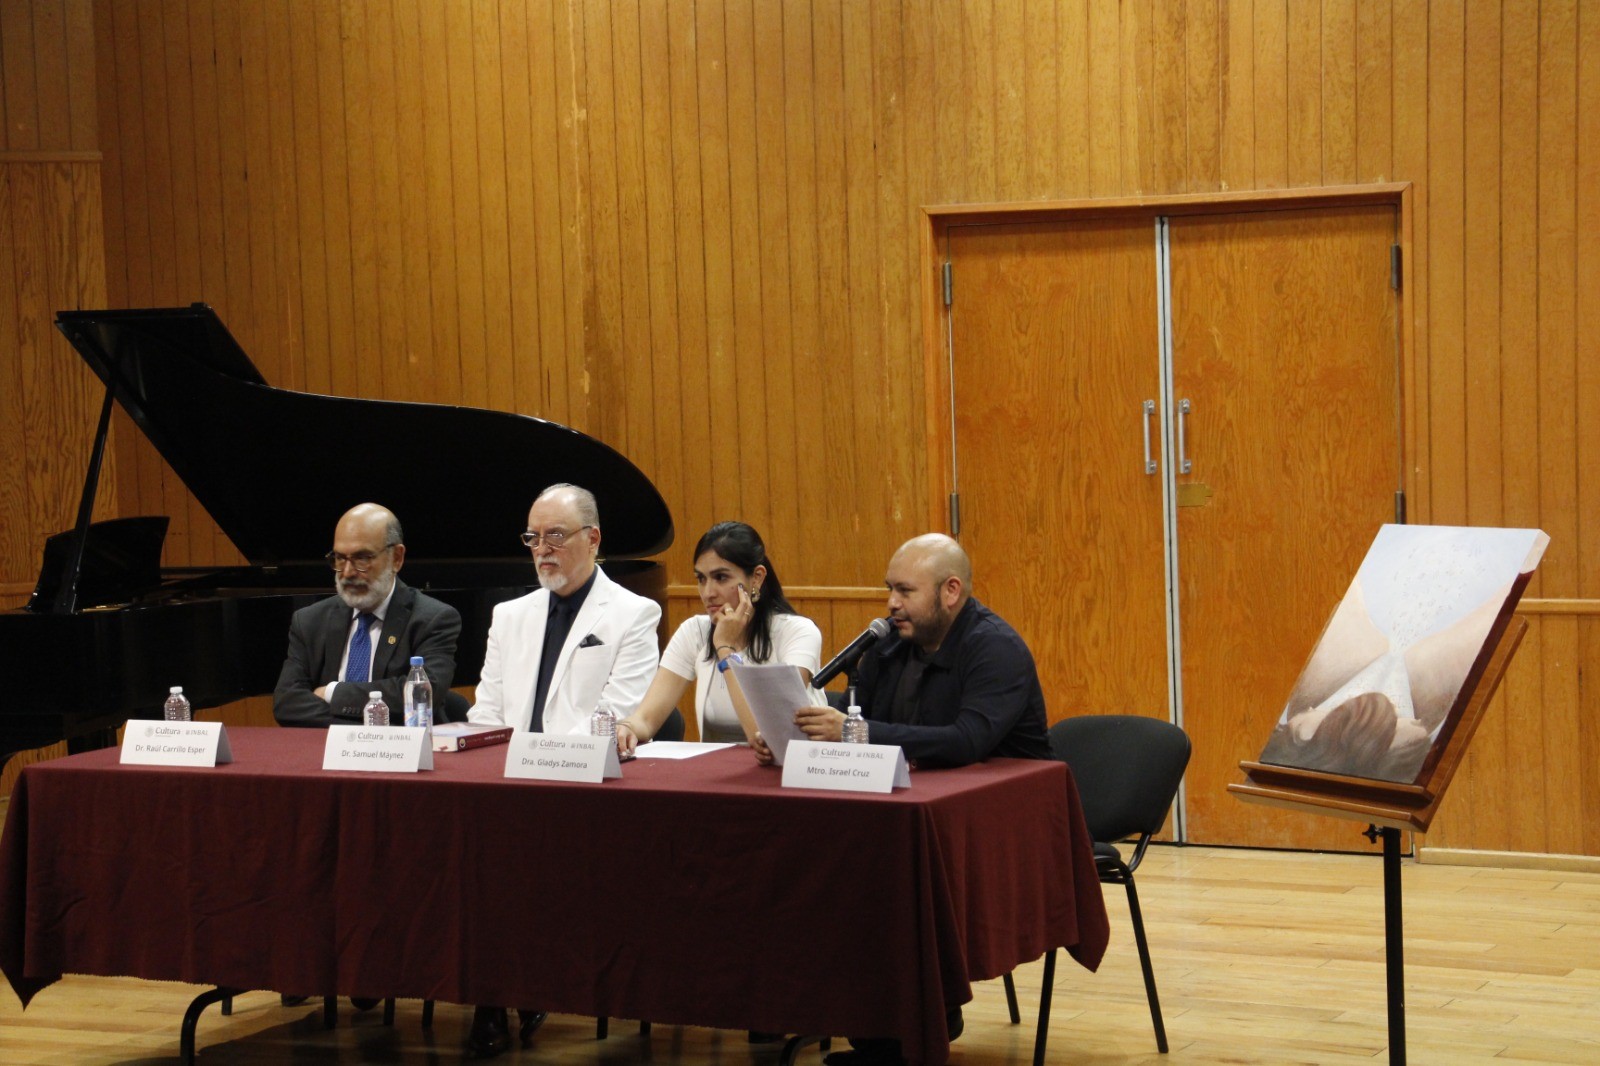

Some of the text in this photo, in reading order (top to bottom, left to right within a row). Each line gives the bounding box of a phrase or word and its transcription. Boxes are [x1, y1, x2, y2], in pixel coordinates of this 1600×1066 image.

[156, 727, 180, 735] Cultura
[358, 732, 383, 740] Cultura
[540, 740, 565, 748] Cultura
[188, 746, 205, 754] Esper
[353, 750, 378, 758] Samuel
[821, 748, 850, 757] Cultura
[538, 758, 560, 768] Gladys
[561, 760, 588, 768] Zamora
[807, 766, 870, 777] Mtro. Israel Cruz
